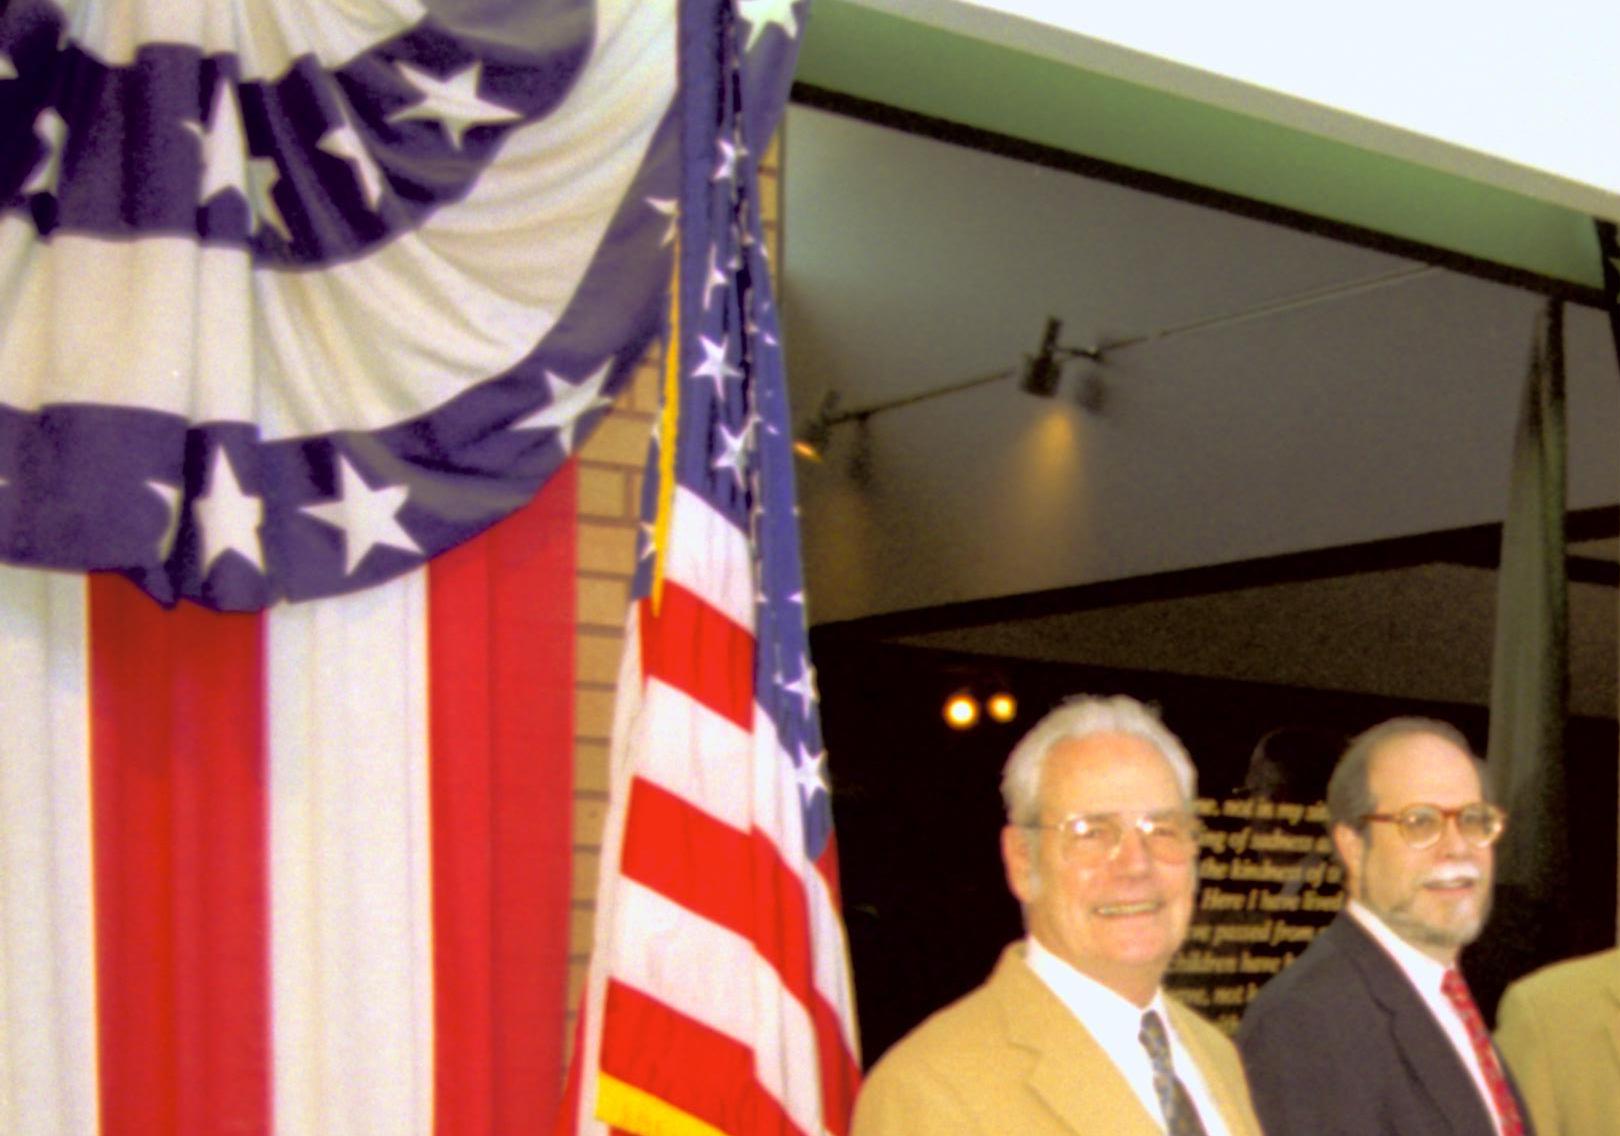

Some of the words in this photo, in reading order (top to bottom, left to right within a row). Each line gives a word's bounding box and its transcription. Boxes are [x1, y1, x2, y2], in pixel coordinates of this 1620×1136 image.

[1277, 803, 1305, 826] my
[1228, 827, 1252, 854] of
[1231, 858, 1303, 881] kindness
[1305, 863, 1327, 888] of
[1201, 887, 1246, 911] Here
[1247, 888, 1259, 911] I
[1213, 919, 1271, 946] passed
[1271, 919, 1314, 946] from
